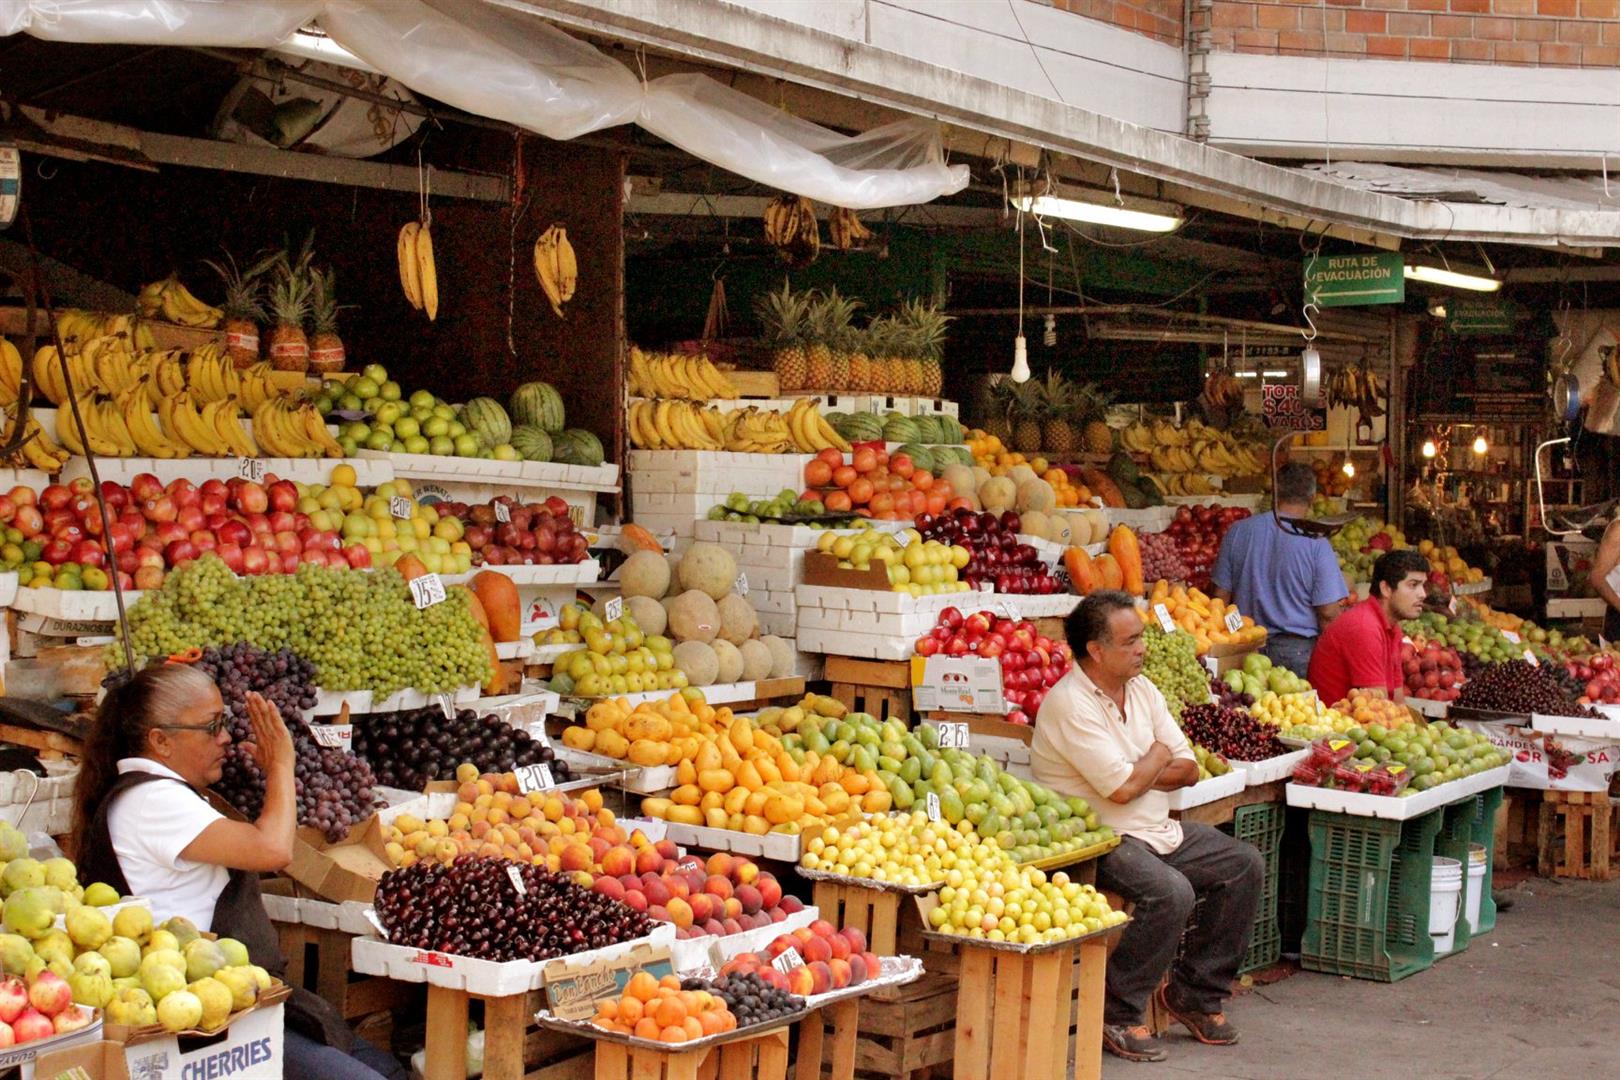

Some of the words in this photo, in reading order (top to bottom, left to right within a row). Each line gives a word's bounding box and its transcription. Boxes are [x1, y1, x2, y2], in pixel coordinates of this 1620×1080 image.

[1328, 258, 1358, 269] RUTA
[1362, 256, 1378, 267] DE
[1316, 267, 1391, 282] EVACUACIÓN
[1262, 384, 1327, 400] TORS
[242, 458, 256, 480] 20
[393, 497, 405, 516] 20
[415, 581, 432, 607] 15
[53, 621, 103, 633] DURAZNOS
[1489, 738, 1537, 751] RANDES
[520, 765, 546, 791] 20
[181, 1037, 273, 1080] CHERRIES
